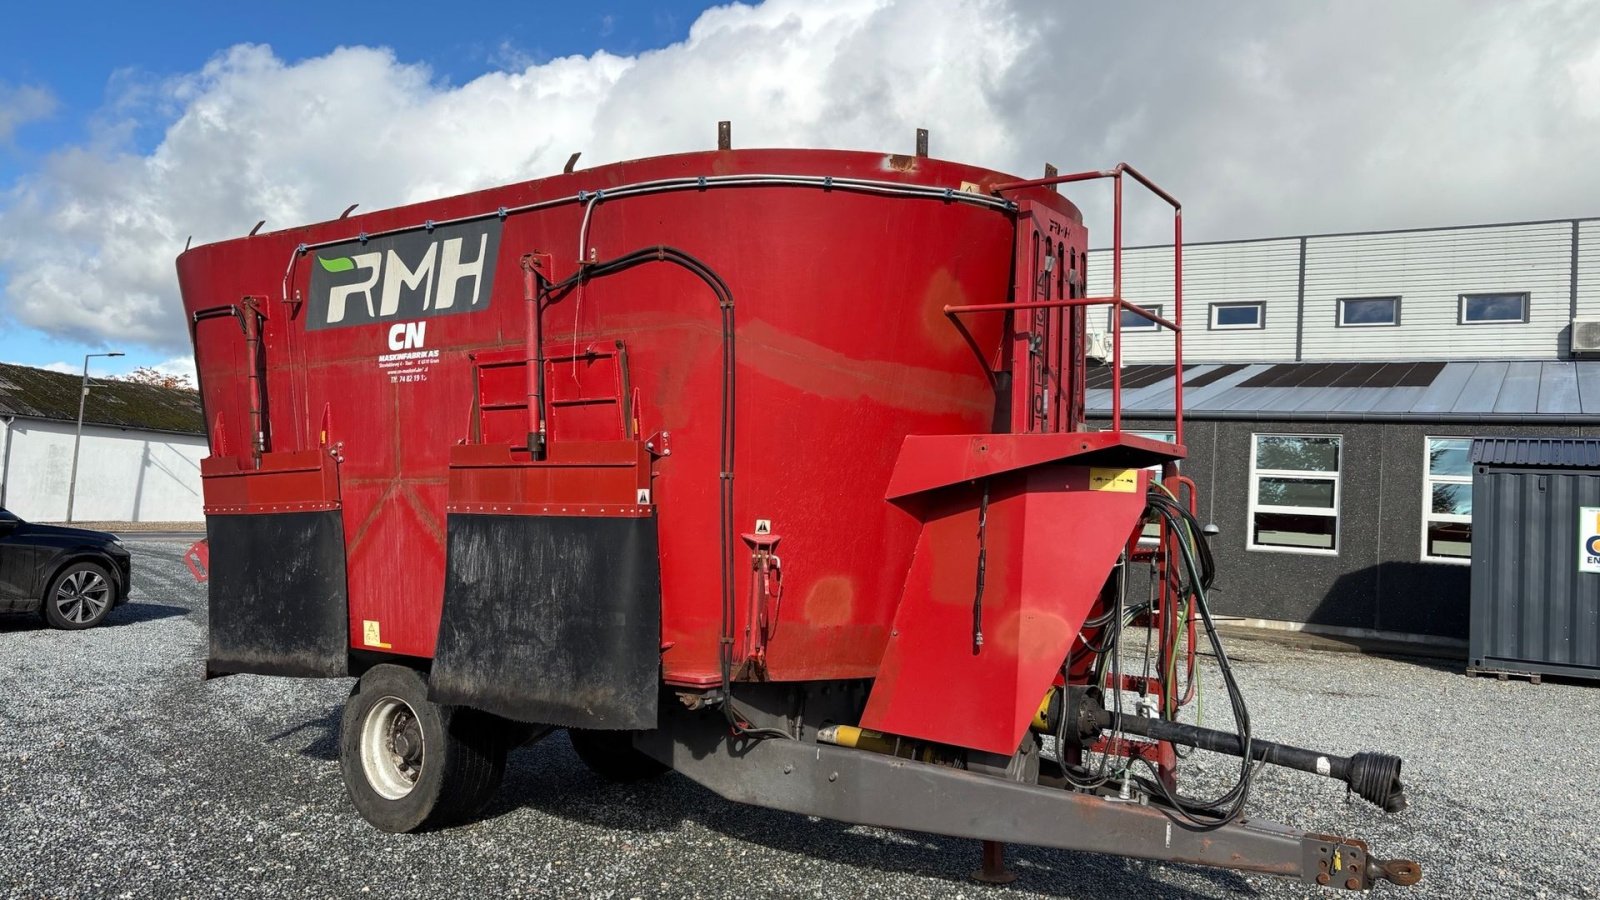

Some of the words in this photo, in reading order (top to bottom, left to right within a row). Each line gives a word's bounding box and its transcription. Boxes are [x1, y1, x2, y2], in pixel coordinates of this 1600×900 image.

[318, 233, 488, 323] RMH
[388, 321, 426, 351] CN
[379, 351, 428, 362] MASKINFABRIK
[428, 350, 439, 358] AS
